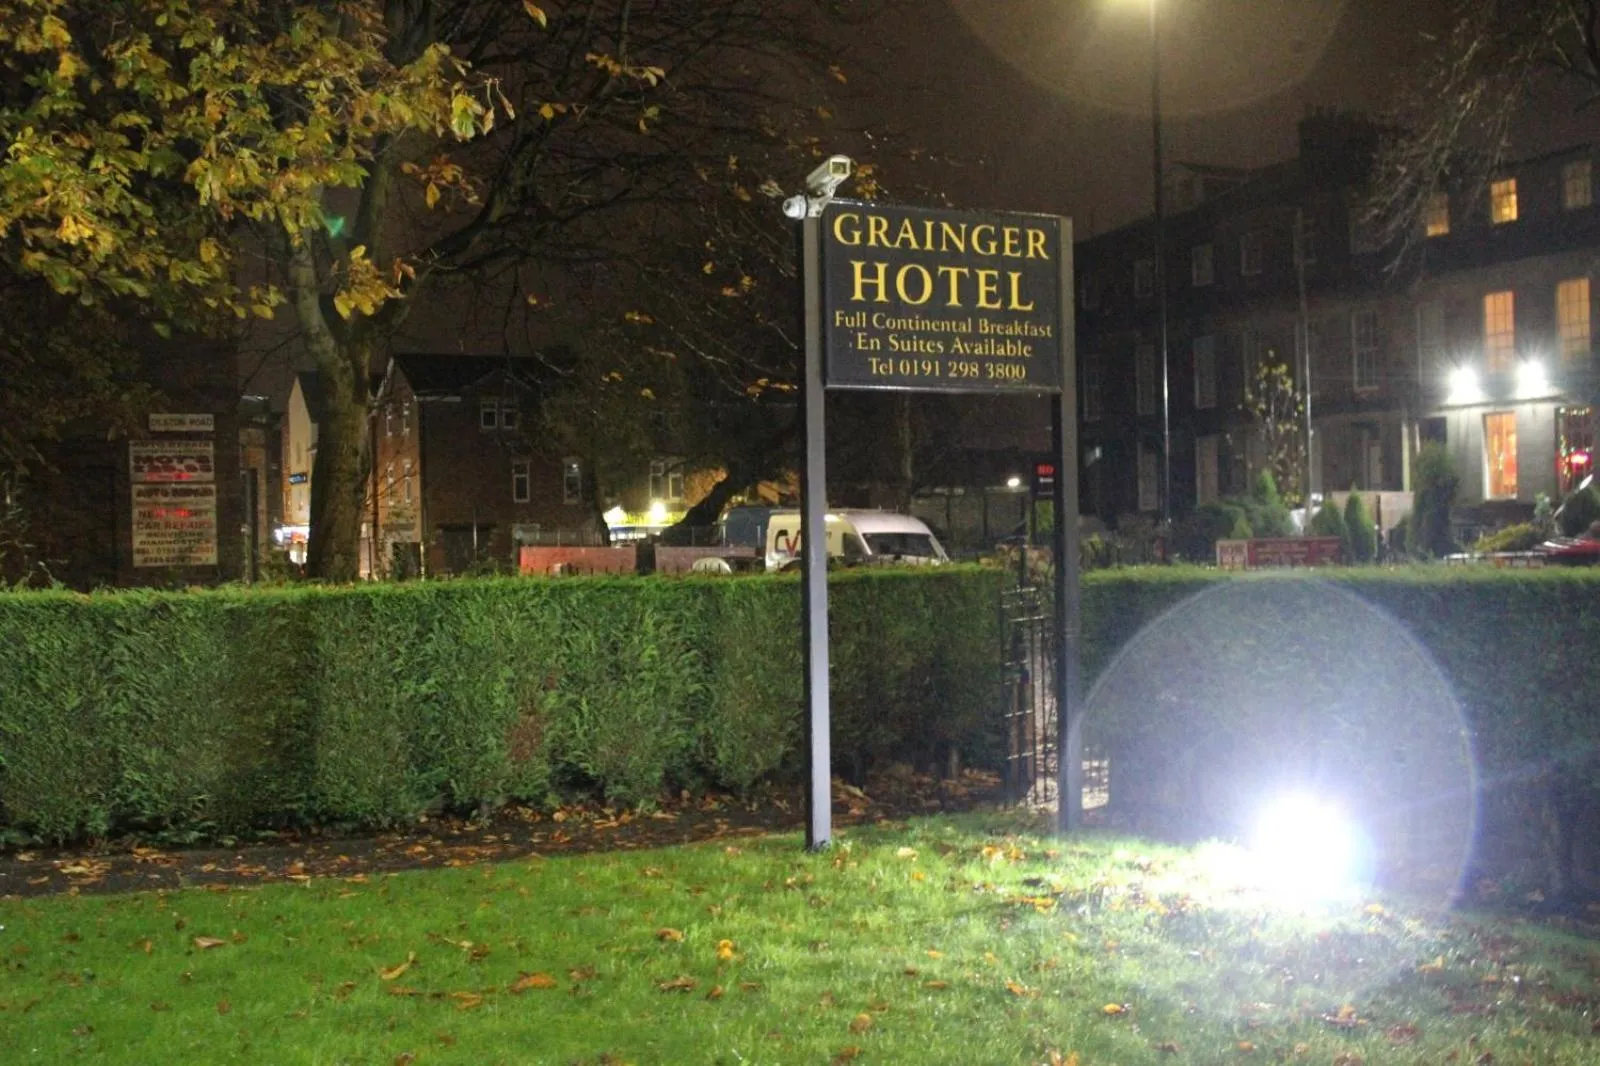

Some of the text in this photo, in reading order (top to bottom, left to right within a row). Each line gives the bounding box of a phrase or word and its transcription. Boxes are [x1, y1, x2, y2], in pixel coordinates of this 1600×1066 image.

[833, 213, 1049, 260] GRAINGER
[850, 260, 1034, 311] HOTEL
[835, 310, 1052, 337] Full Continental Breakfast
[856, 332, 1033, 357] En Suites Available
[868, 356, 1026, 379] Tel 0191 298 3800
[189, 418, 213, 427] ROAD
